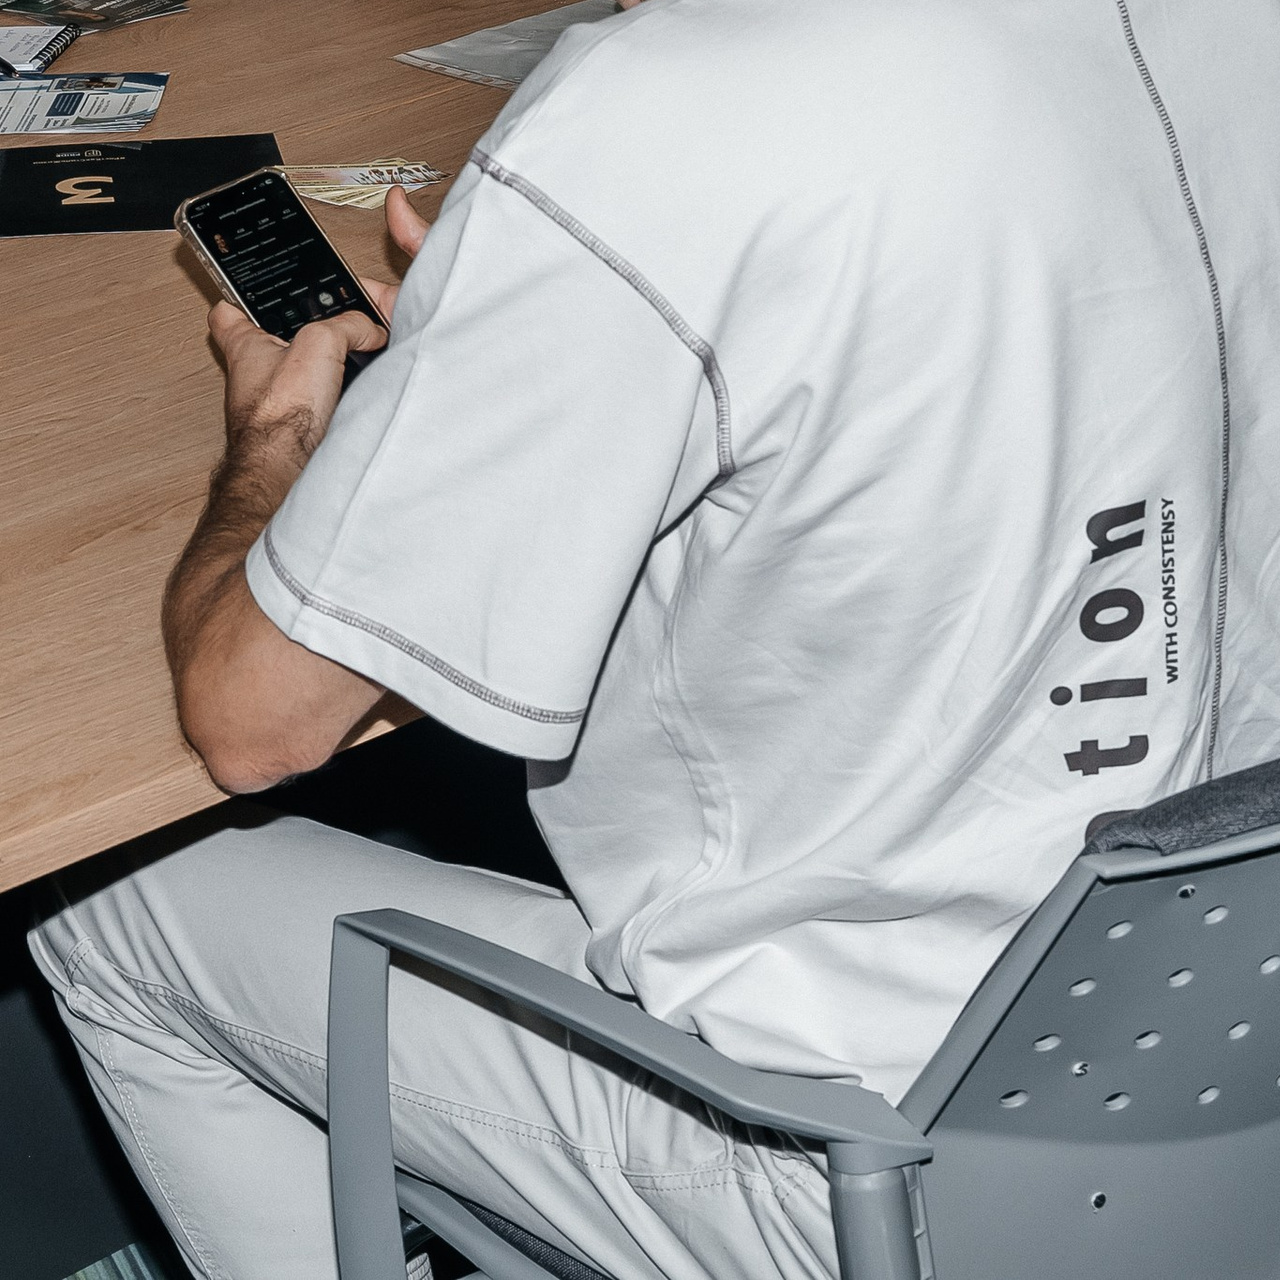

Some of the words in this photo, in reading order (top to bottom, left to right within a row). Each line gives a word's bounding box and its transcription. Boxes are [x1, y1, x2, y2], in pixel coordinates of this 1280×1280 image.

[55, 175, 116, 206] 3
[1160, 497, 1178, 628] CONSISTENSY
[1049, 499, 1150, 777] tion
[1164, 631, 1179, 684] WITH
